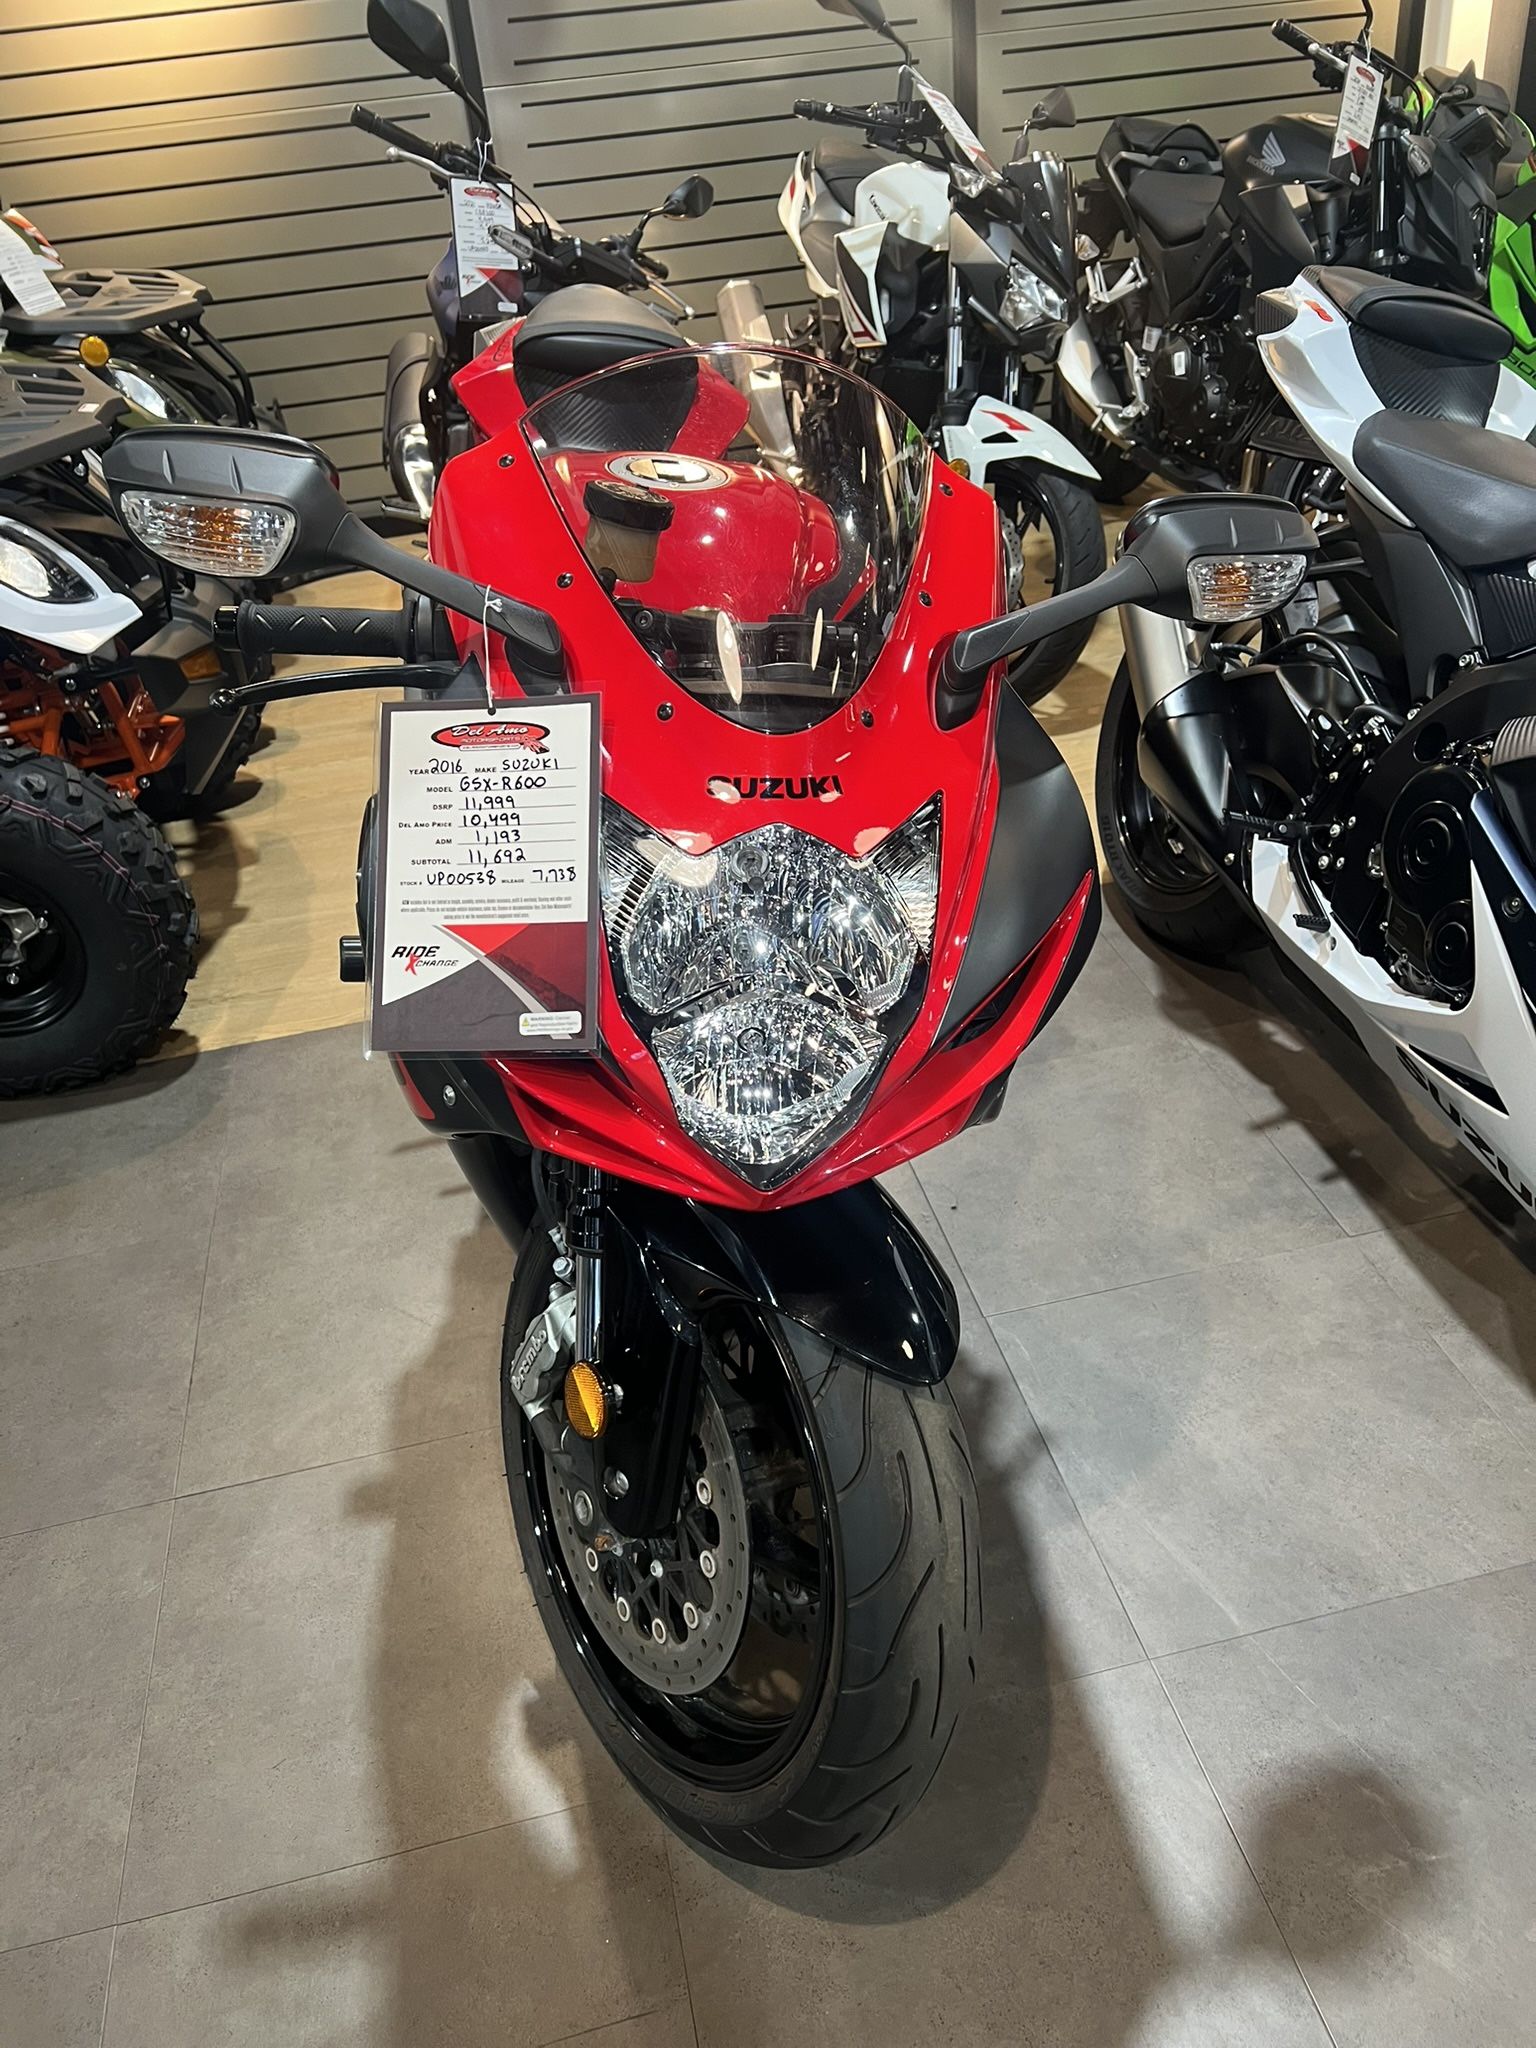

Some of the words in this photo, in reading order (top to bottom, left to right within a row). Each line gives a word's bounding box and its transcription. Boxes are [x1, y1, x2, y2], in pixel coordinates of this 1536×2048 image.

[1246, 155, 1275, 176] HONDA
[451, 726, 485, 736] Del
[487, 724, 529, 735] Amo
[429, 758, 463, 774] 2016
[502, 758, 559, 771] SUZUKI
[465, 796, 515, 811] 11,999
[463, 813, 520, 828] 10,499
[475, 829, 520, 846] 1,193
[469, 848, 526, 868] 11,692
[427, 871, 496, 886] UP00538
[532, 866, 577, 883] 7,738
[391, 945, 440, 958] RIDE
[1396, 1046, 1536, 1212] SUZU
[511, 1329, 547, 1391] brembo
